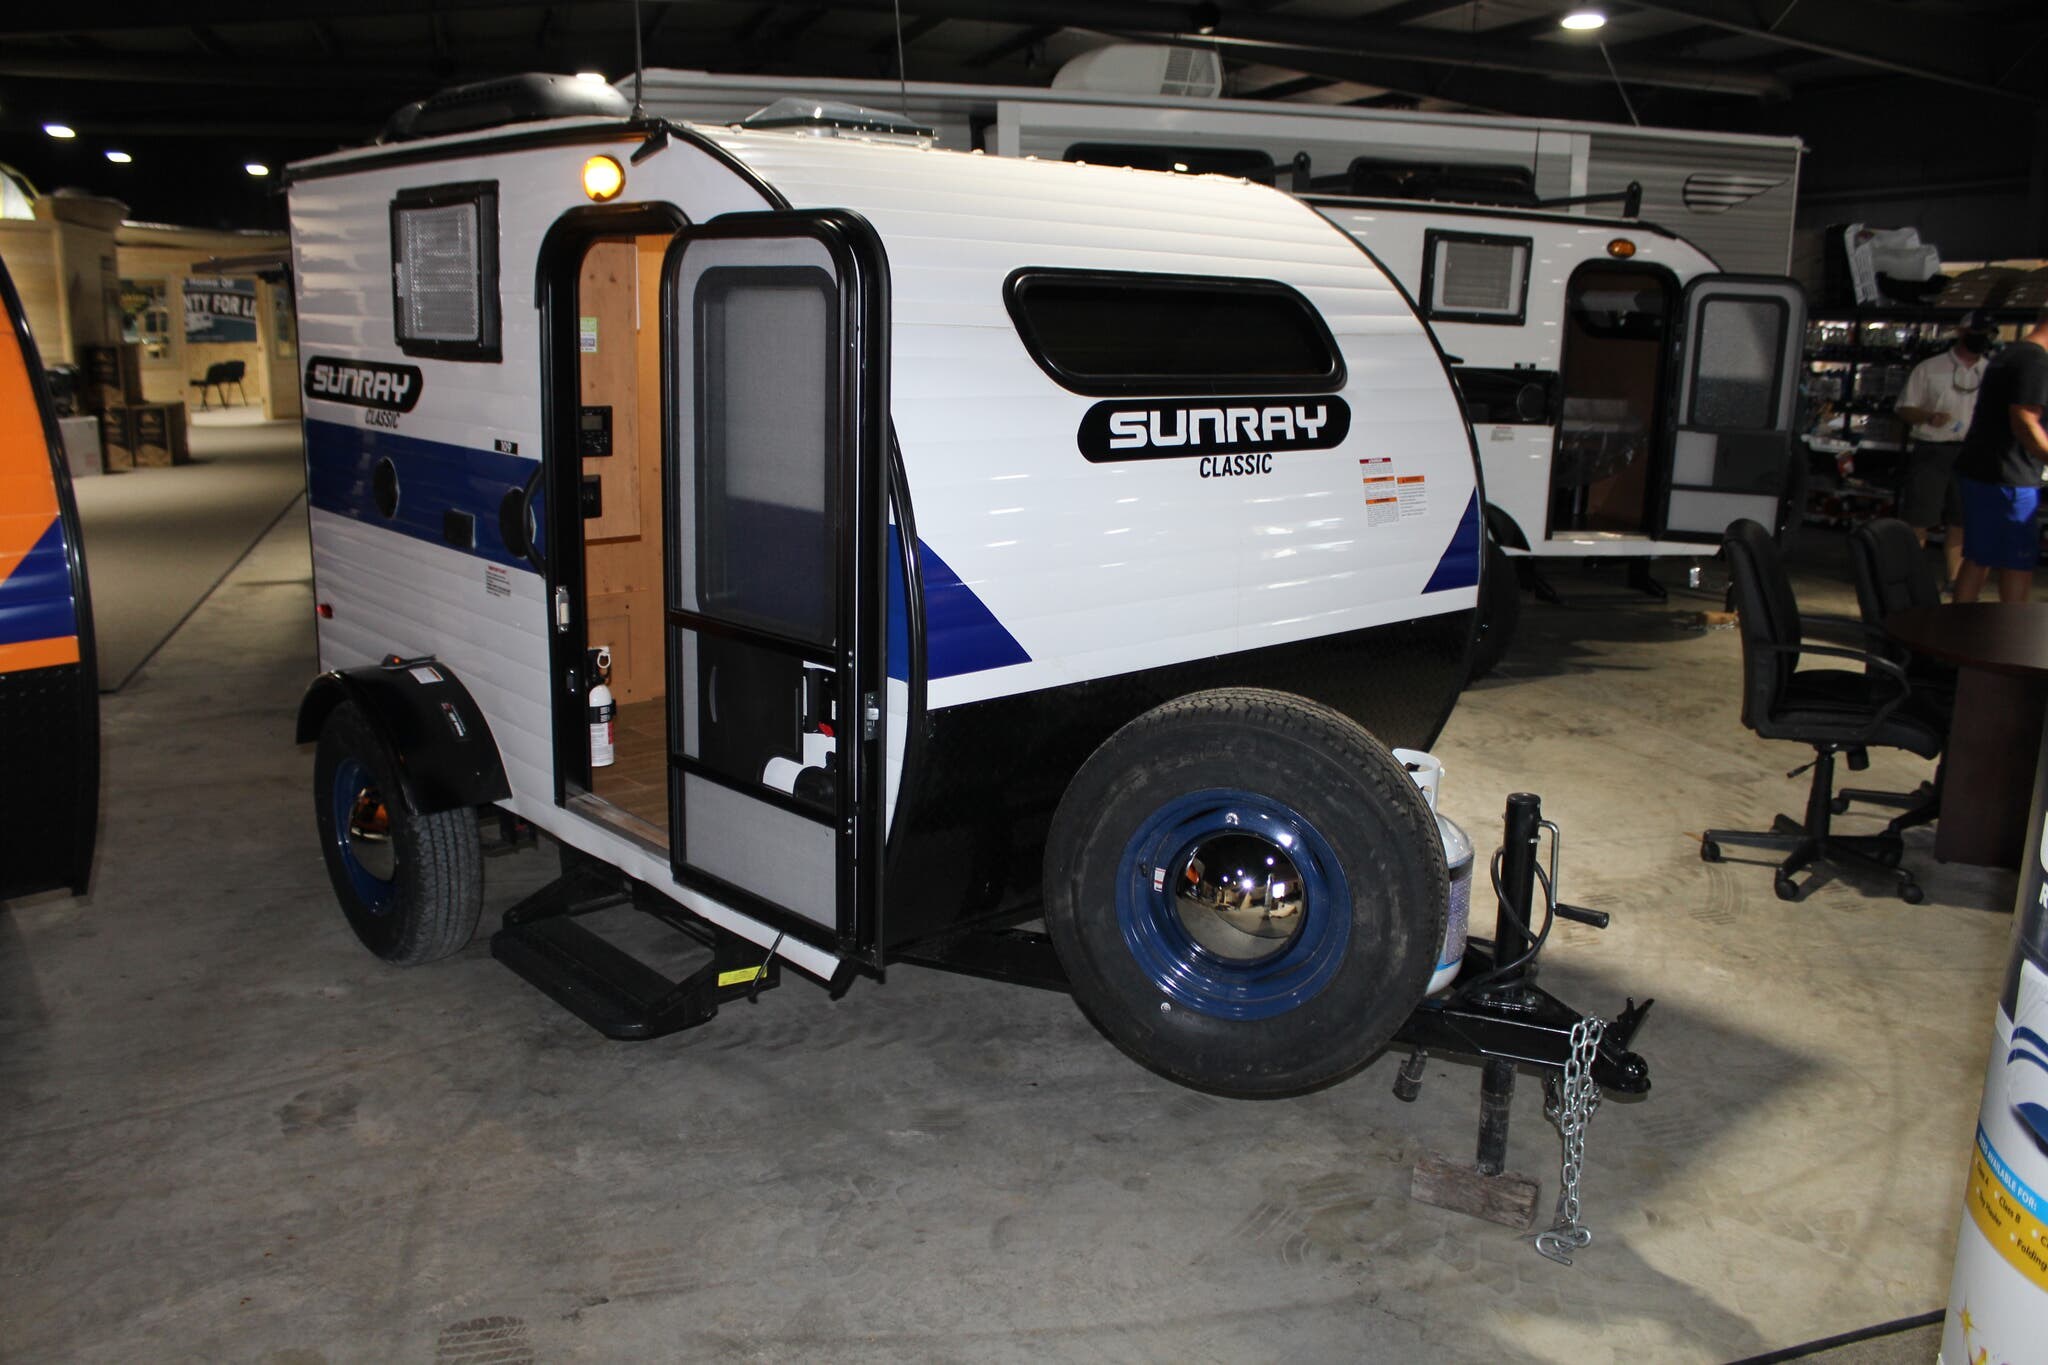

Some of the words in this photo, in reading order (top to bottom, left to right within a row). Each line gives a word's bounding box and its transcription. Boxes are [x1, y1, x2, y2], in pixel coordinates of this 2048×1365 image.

[212, 294, 240, 316] FOR
[312, 364, 410, 403] SUNRAY
[364, 408, 400, 429] CLASSIC
[1110, 405, 1327, 449] SUNRAY
[1199, 453, 1273, 478] CLASSIC
[1988, 1151, 2016, 1192] AVAILABLE
[1999, 1196, 2014, 1218] Class
[2015, 1213, 2021, 1224] B
[2017, 1238, 2047, 1272] Folding
